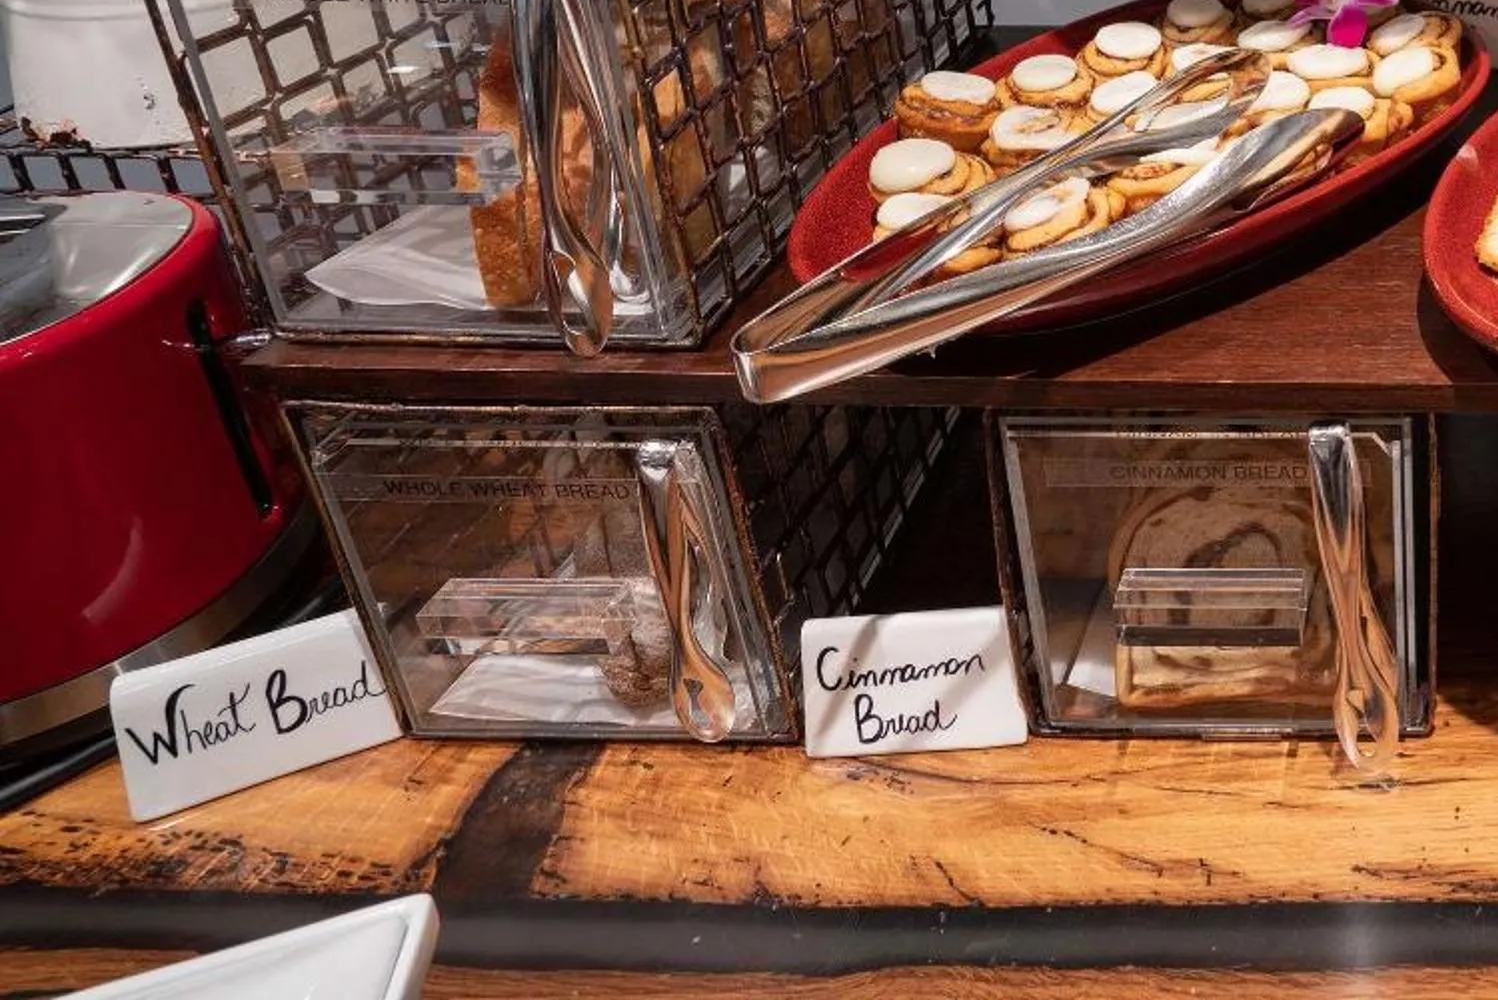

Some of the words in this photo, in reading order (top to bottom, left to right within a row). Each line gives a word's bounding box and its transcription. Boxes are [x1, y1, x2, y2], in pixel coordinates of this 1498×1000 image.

[382, 479, 460, 498] WHOLE
[469, 480, 547, 499] WHEAT
[554, 483, 630, 501] BREAD
[1109, 464, 1227, 481] CINNAMON
[1233, 465, 1308, 481] BREAD
[816, 646, 986, 692] Cinnamon
[124, 682, 257, 766] Wheat
[264, 660, 388, 736] Bread
[854, 693, 959, 745] Bread
